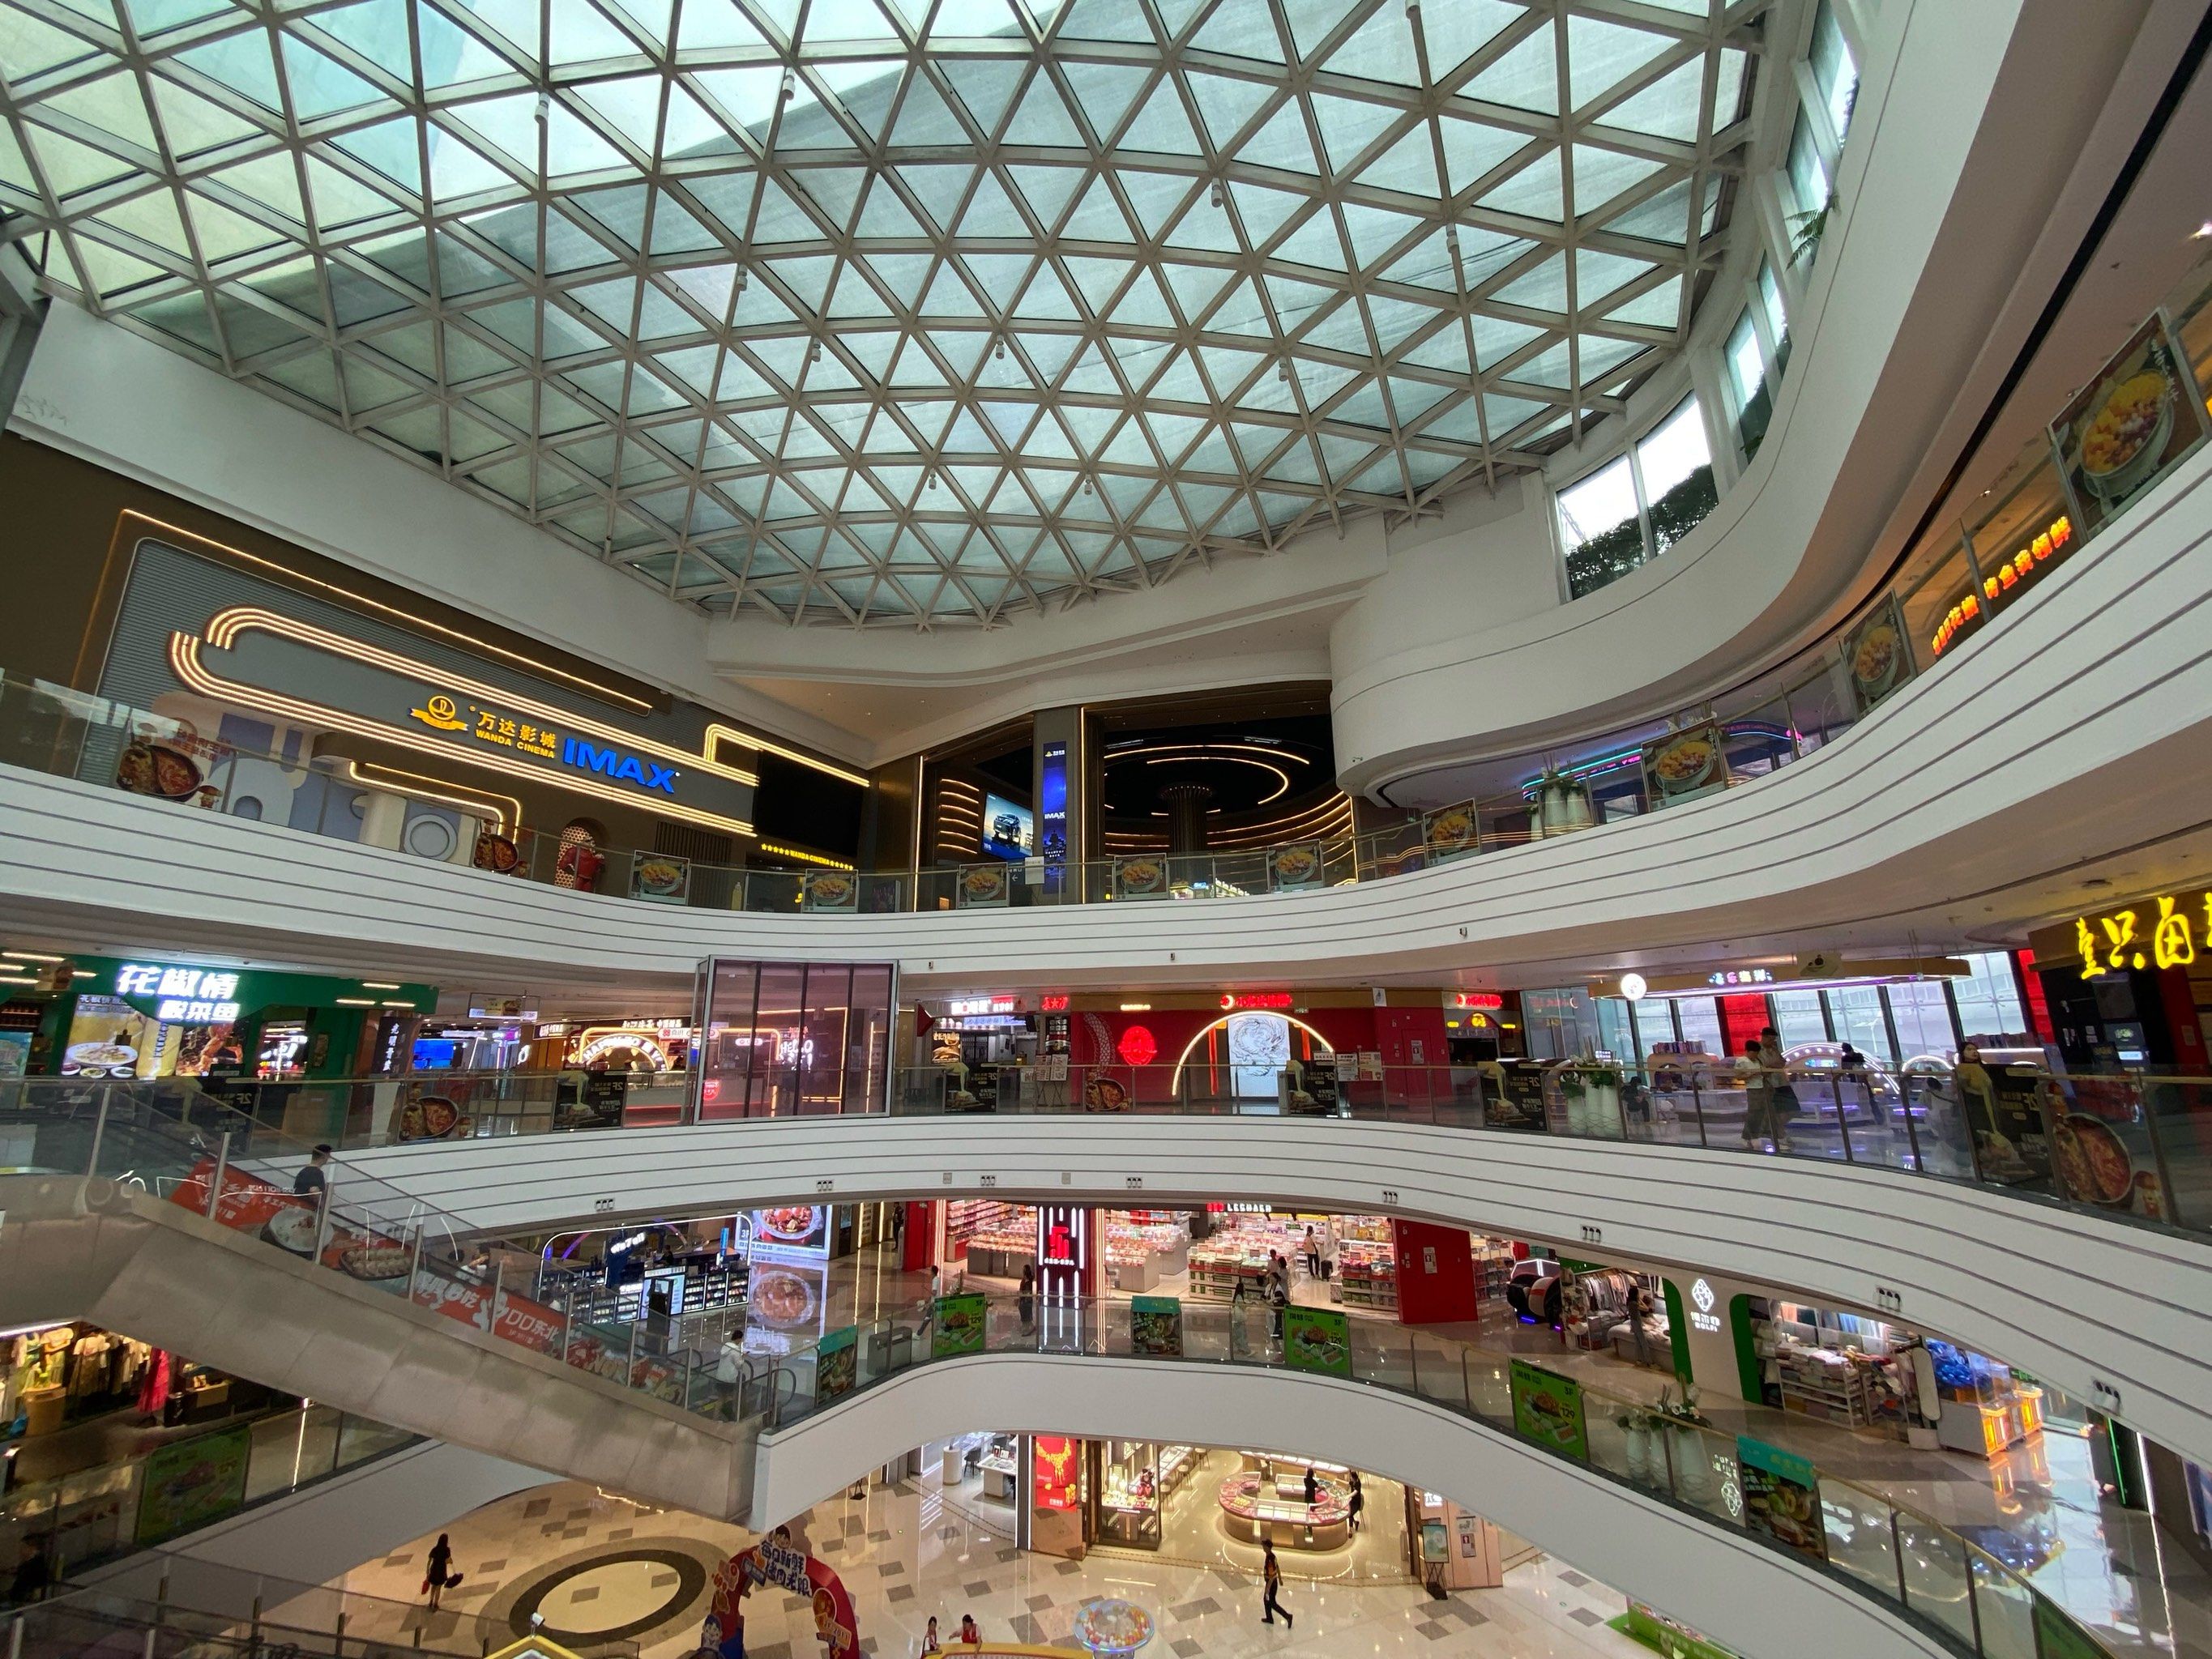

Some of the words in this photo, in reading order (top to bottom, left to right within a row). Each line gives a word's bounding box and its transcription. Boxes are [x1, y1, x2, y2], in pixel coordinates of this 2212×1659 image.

[476, 729, 512, 746] WANDA
[516, 741, 557, 758] CINEMA
[477, 711, 557, 749] 万达影城
[563, 738, 676, 794] IMAX
[117, 964, 240, 1000] 花椒情
[159, 1000, 240, 1022] 酸菜鱼
